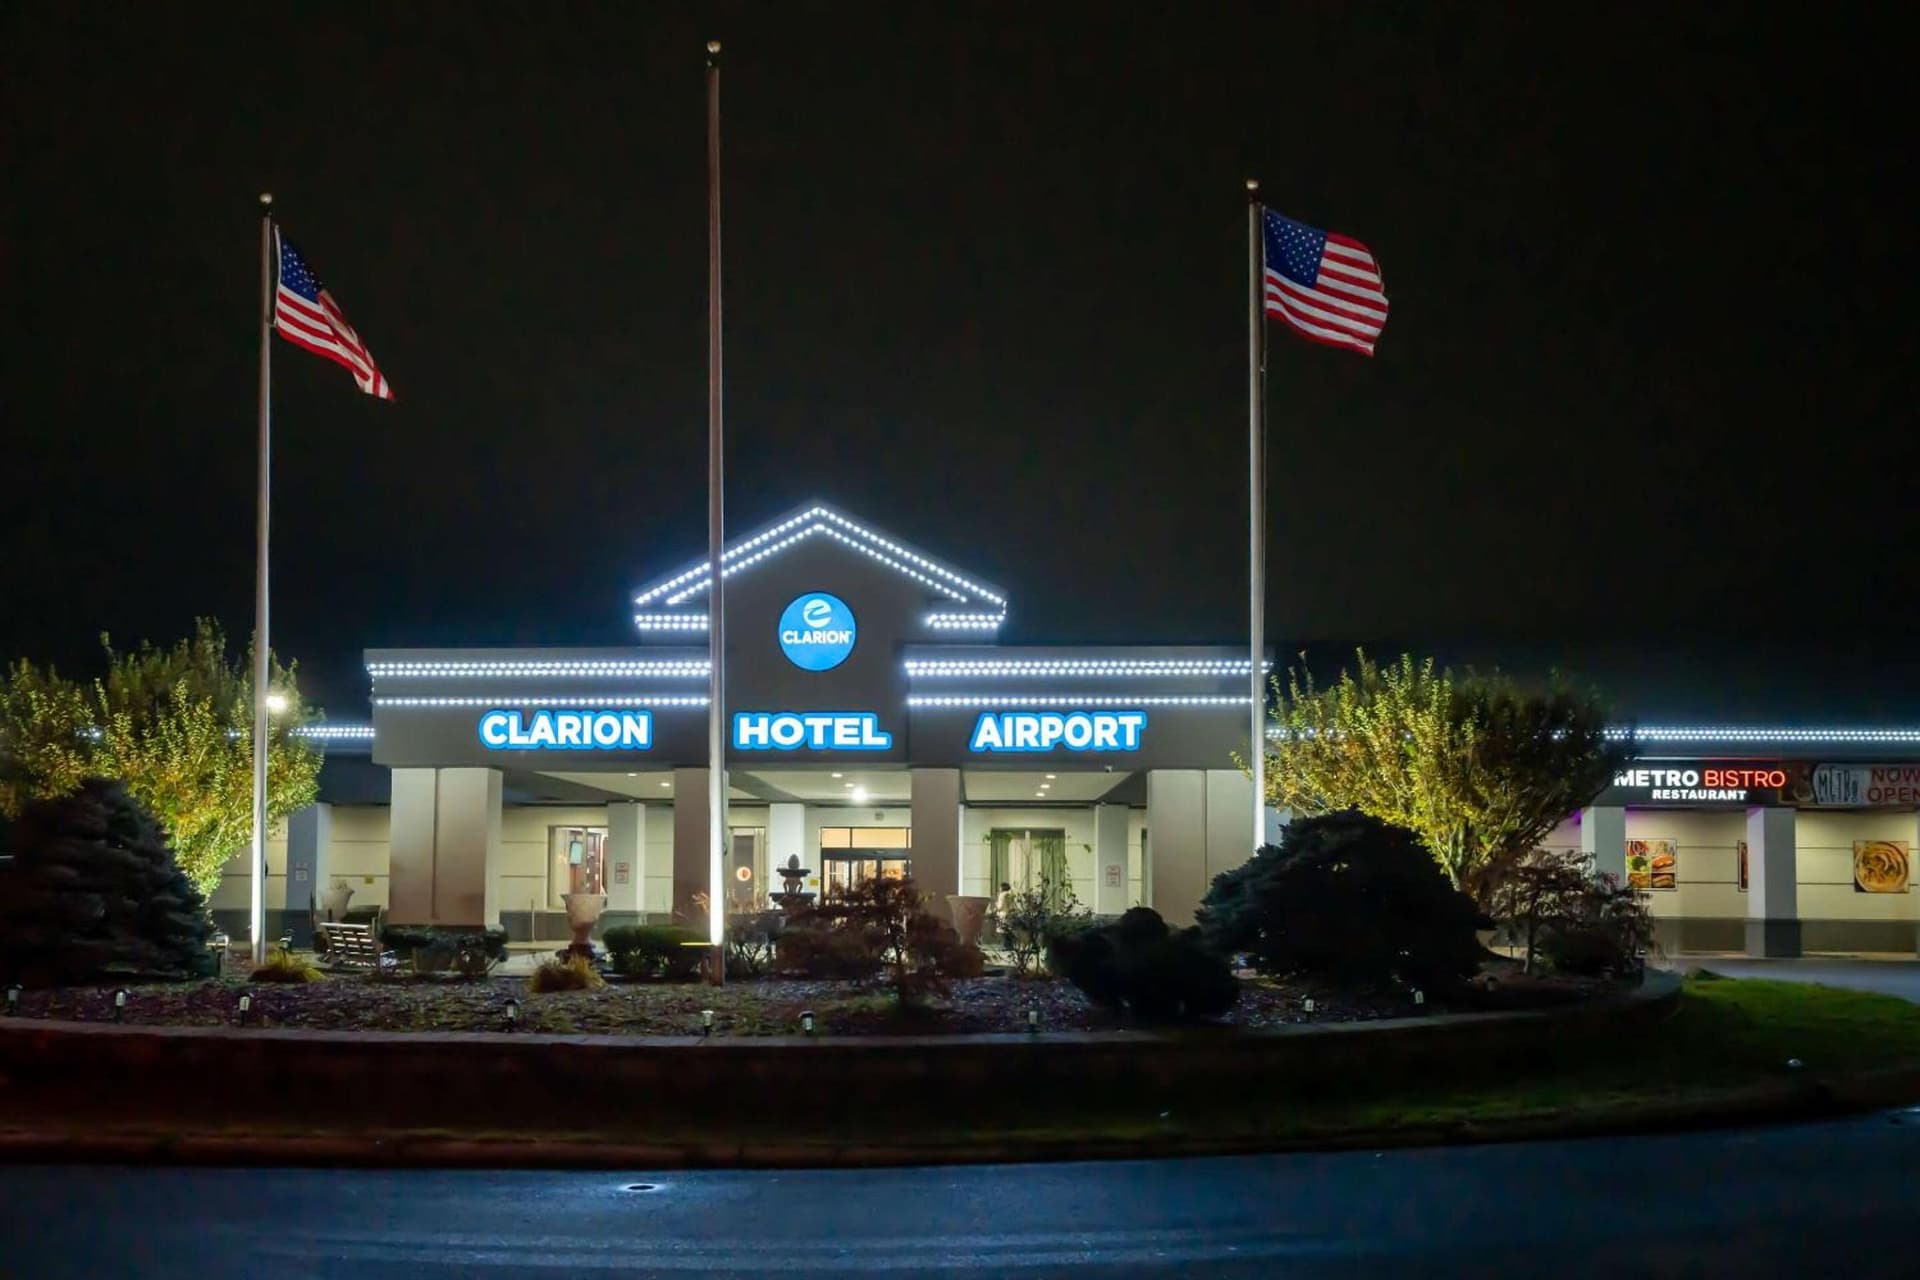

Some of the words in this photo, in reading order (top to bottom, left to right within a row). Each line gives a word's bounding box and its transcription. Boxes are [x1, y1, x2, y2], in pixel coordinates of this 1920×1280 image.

[782, 629, 850, 645] CLARION
[481, 713, 650, 747] CLARION
[738, 715, 889, 747] HOTEL
[973, 714, 1144, 748] AIRPORT
[1613, 769, 1700, 787] METRO
[1704, 769, 1786, 788] BISTRO
[1652, 789, 1747, 801] RESTAURANT
